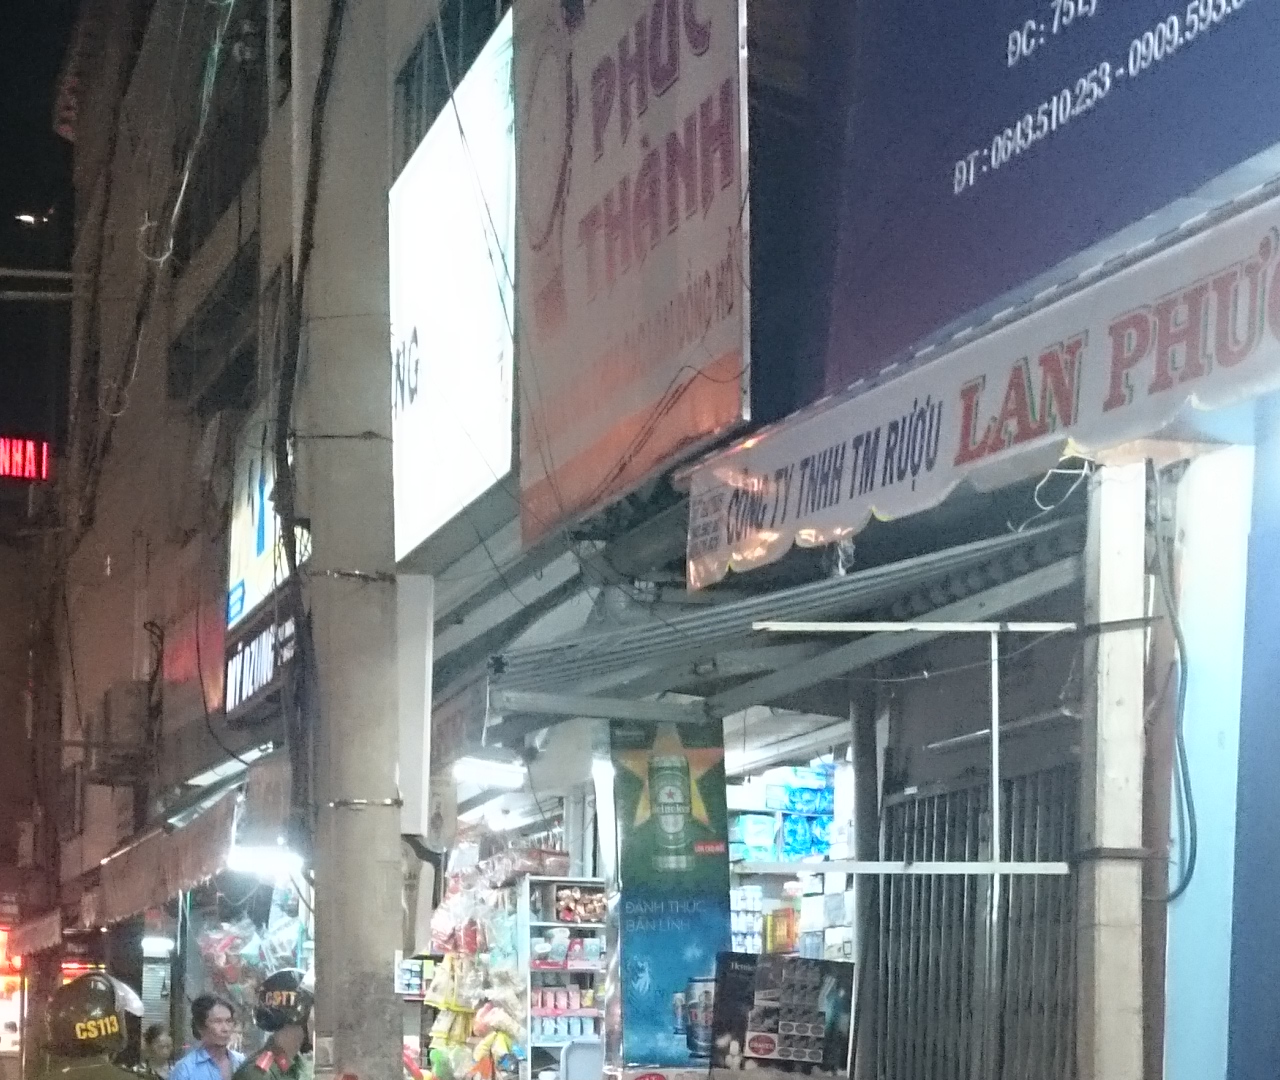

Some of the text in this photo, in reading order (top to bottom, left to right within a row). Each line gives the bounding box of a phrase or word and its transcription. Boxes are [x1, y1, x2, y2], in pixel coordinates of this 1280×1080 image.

[990, 62, 1110, 169] 0643.510.253
[1128, 0, 1245, 77] 0909.593.
[771, 463, 795, 528] TY
[796, 441, 847, 519] TNHH
[849, 427, 882, 499] TM
[954, 330, 1089, 467] LAN
[75, 1015, 120, 1041] CS113
